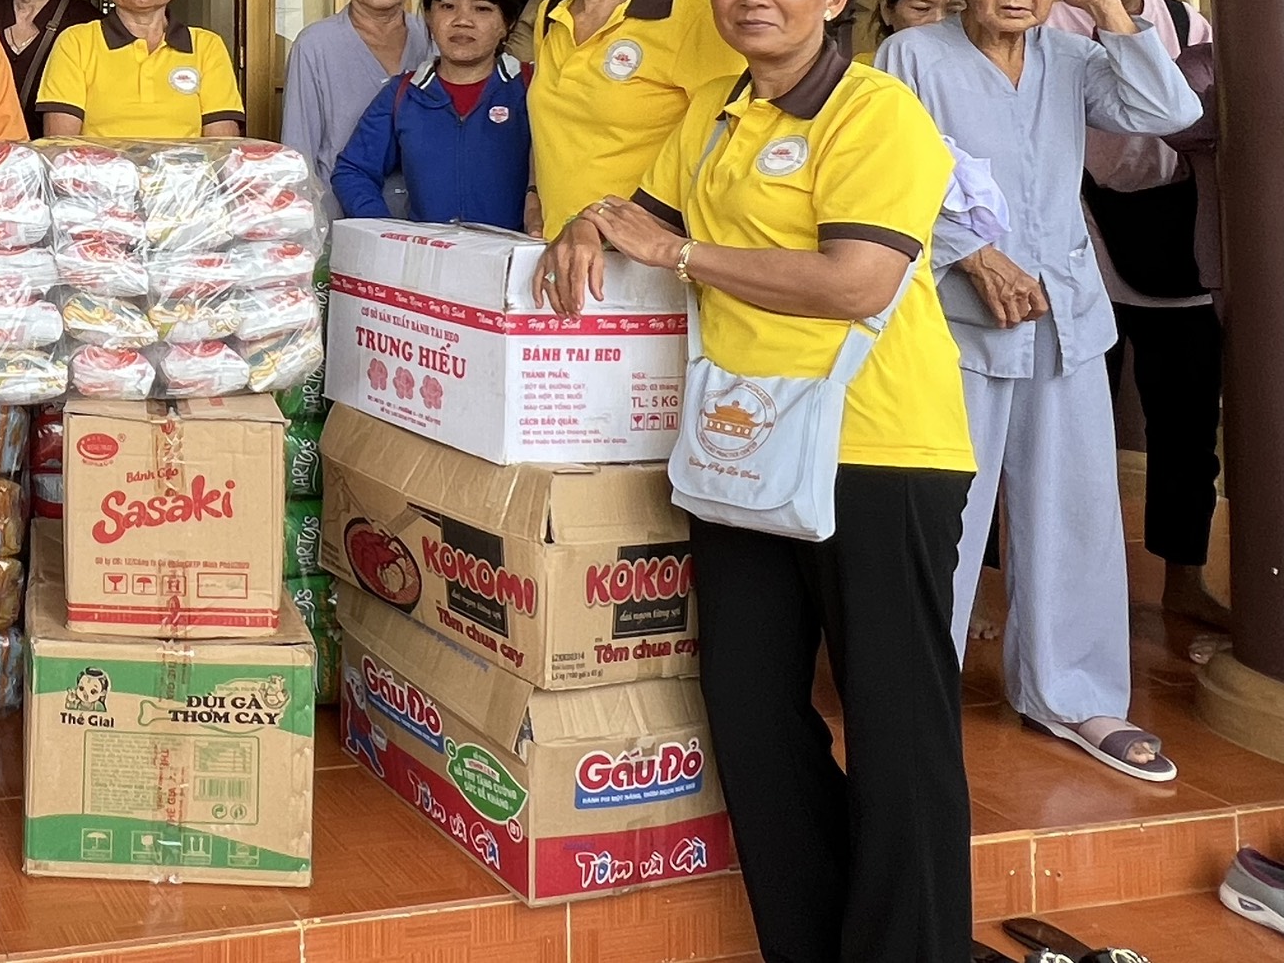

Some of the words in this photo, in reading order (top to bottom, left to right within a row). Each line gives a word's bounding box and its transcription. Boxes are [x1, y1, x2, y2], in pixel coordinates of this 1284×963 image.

[356, 326, 413, 362] TRUNG
[418, 343, 466, 379] HIẾU
[444, 331, 459, 343] HEO
[522, 345, 561, 361] BÁNH
[566, 348, 589, 361] TAI
[595, 348, 621, 361] HEO
[652, 396, 658, 407] 5
[661, 396, 678, 407] KG
[92, 474, 236, 544] Sasaki
[421, 536, 536, 616] KOKOMI
[436, 605, 463, 634] Tôm
[466, 623, 498, 653] chua
[500, 643, 525, 668] cay
[594, 643, 629, 664] Tôm
[632, 639, 671, 659] chua
[169, 708, 229, 723] THƠM
[235, 711, 280, 725] CAY
[186, 689, 224, 709] ĐÙI
[231, 693, 263, 709] GÀ
[407, 769, 446, 823] Tôm
[576, 850, 633, 888] Tôm
[640, 851, 664, 878] và
[670, 836, 708, 873] Gà
